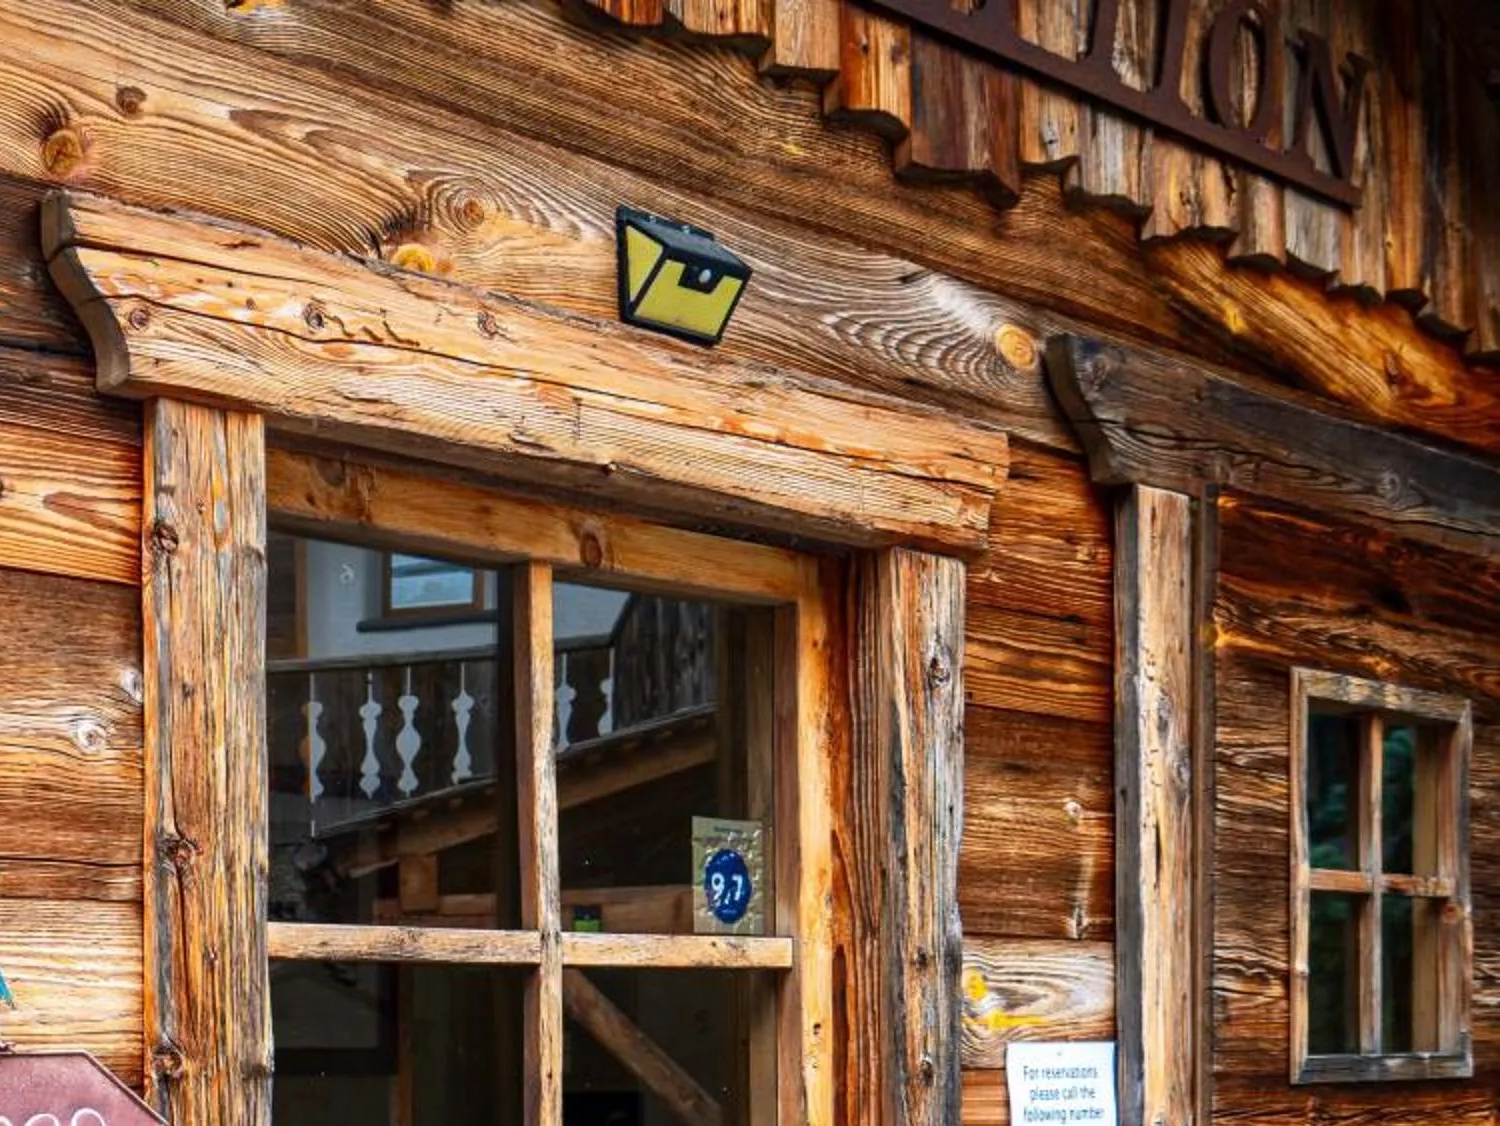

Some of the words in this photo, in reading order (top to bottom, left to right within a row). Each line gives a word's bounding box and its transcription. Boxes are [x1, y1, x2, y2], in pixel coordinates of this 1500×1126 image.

[1023, 1065, 1039, 1082] For
[1043, 1068, 1099, 1081] reservations
[1030, 1088, 1061, 1106] please
[1062, 1087, 1078, 1103] call
[1080, 1085, 1097, 1100] the
[1023, 1106, 1067, 1126] following
[1069, 1107, 1105, 1121] number
